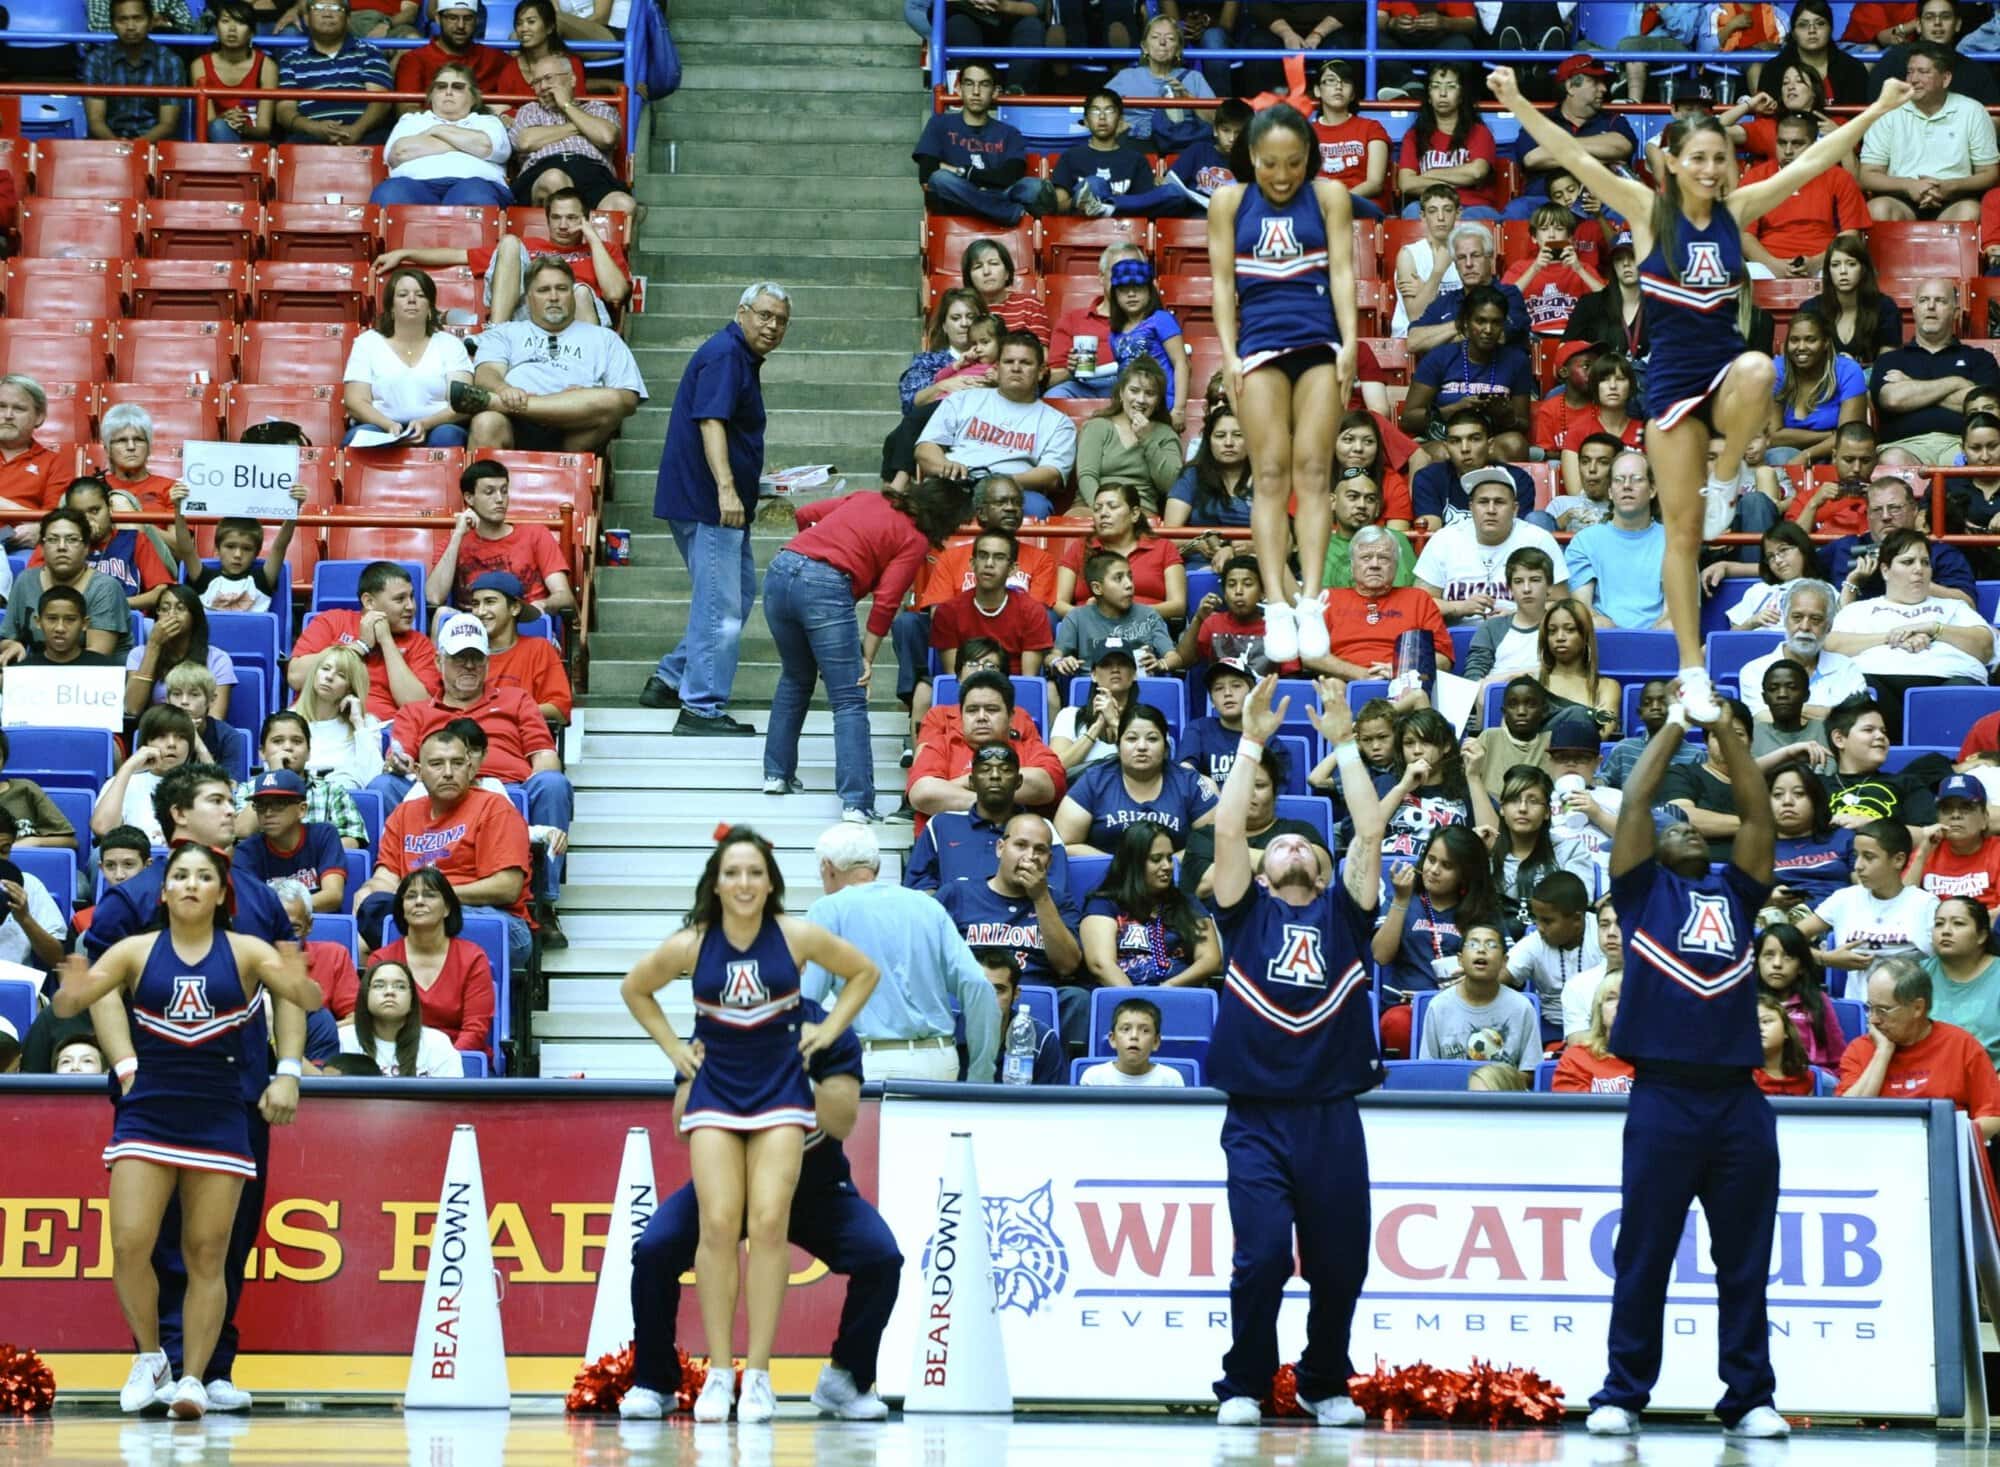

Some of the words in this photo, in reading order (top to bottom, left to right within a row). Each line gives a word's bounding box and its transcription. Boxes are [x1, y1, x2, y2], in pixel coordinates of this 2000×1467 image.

[1253, 217, 1303, 258] A
[1680, 242, 1729, 287] A
[967, 416, 1036, 453] ARIZONA
[187, 463, 224, 487] Go
[233, 464, 292, 490] Blue
[56, 683, 118, 706] Blue
[1106, 810, 1180, 832] ARIZONA
[1679, 892, 1736, 960] A
[1268, 924, 1328, 989] A
[165, 976, 216, 1021] A
[720, 960, 771, 1006] A
[1081, 1309, 1228, 1328] EVER
[1373, 1312, 1575, 1333] EMBER
